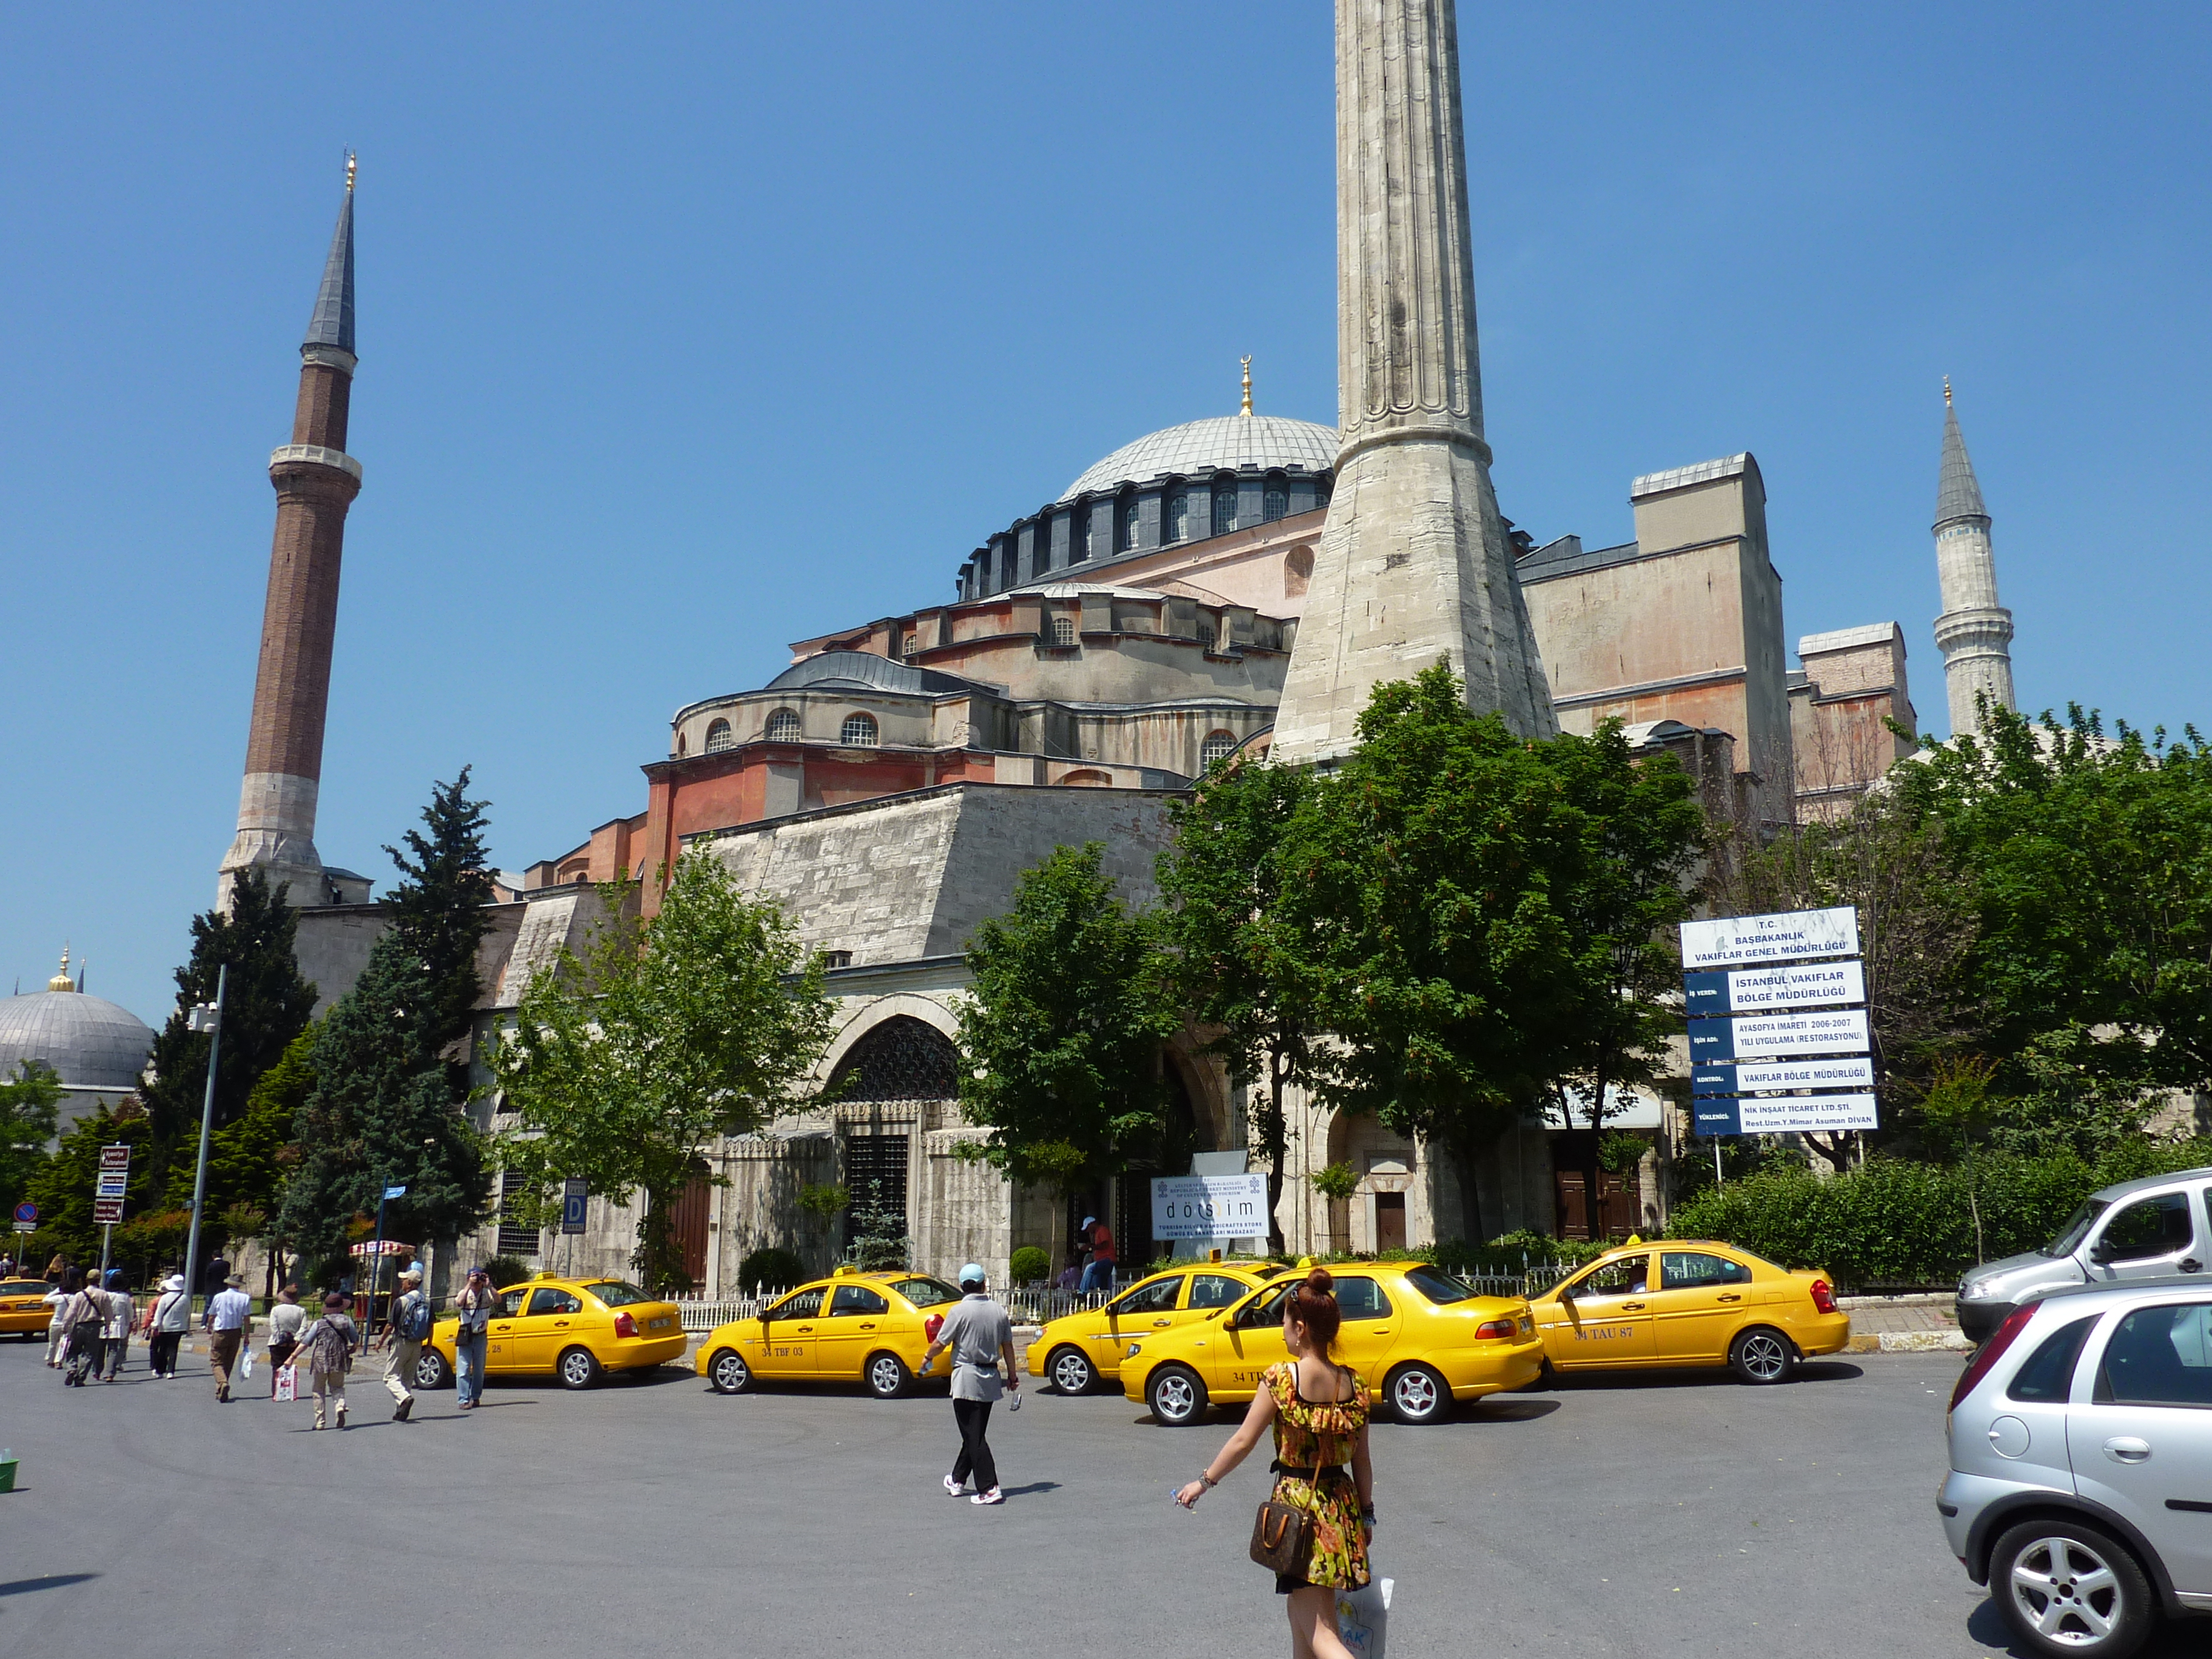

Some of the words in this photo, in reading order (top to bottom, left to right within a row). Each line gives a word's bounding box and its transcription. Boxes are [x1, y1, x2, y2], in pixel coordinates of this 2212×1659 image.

[1759, 920, 1778, 929] T.C.
[1735, 931, 1805, 945] BAŞBAKANLIK
[1695, 949, 1742, 962] VAKIFLAR
[1746, 948, 1778, 957] GENEL
[1781, 941, 1846, 954] MÜDÜRLÜĞÜ
[1736, 976, 1788, 988] İSTANBUL
[1791, 971, 1844, 984] VAKIFLAR
[1737, 991, 1772, 1003] BÖLGE
[1776, 985, 1846, 1000] MÜDÜRLÜĞÜ
[1739, 1023, 1775, 1033] AYASOFYA
[1777, 1021, 1807, 1030] İMARETİ
[1811, 1019, 1851, 1028] 2006-2007
[1756, 1035, 1794, 1045] UYGULAMA
[1744, 1073, 1781, 1083] VAKIFLAR
[1785, 1070, 1811, 1080] BÖLGE
[1814, 1067, 1865, 1079] MÜDÜRLÜĞÜ
[1760, 1105, 1786, 1114] İNŞAAT
[1788, 1103, 1819, 1112] TİCARET
[1822, 1102, 1851, 1113] LTD.ŞTİ.
[1746, 1118, 1812, 1127] Rest.Uzm.Y.Mimar
[1848, 1115, 1872, 1124] DİVAN
[569, 1197, 581, 1221] D
[1575, 1330, 1587, 1341] 34
[1590, 1328, 1616, 1339] TAU
[1620, 1327, 1632, 1337] 87
[762, 1348, 772, 1357] 34
[774, 1347, 789, 1356] TBF
[793, 1347, 803, 1356] 03
[1233, 1372, 1245, 1382] 34
